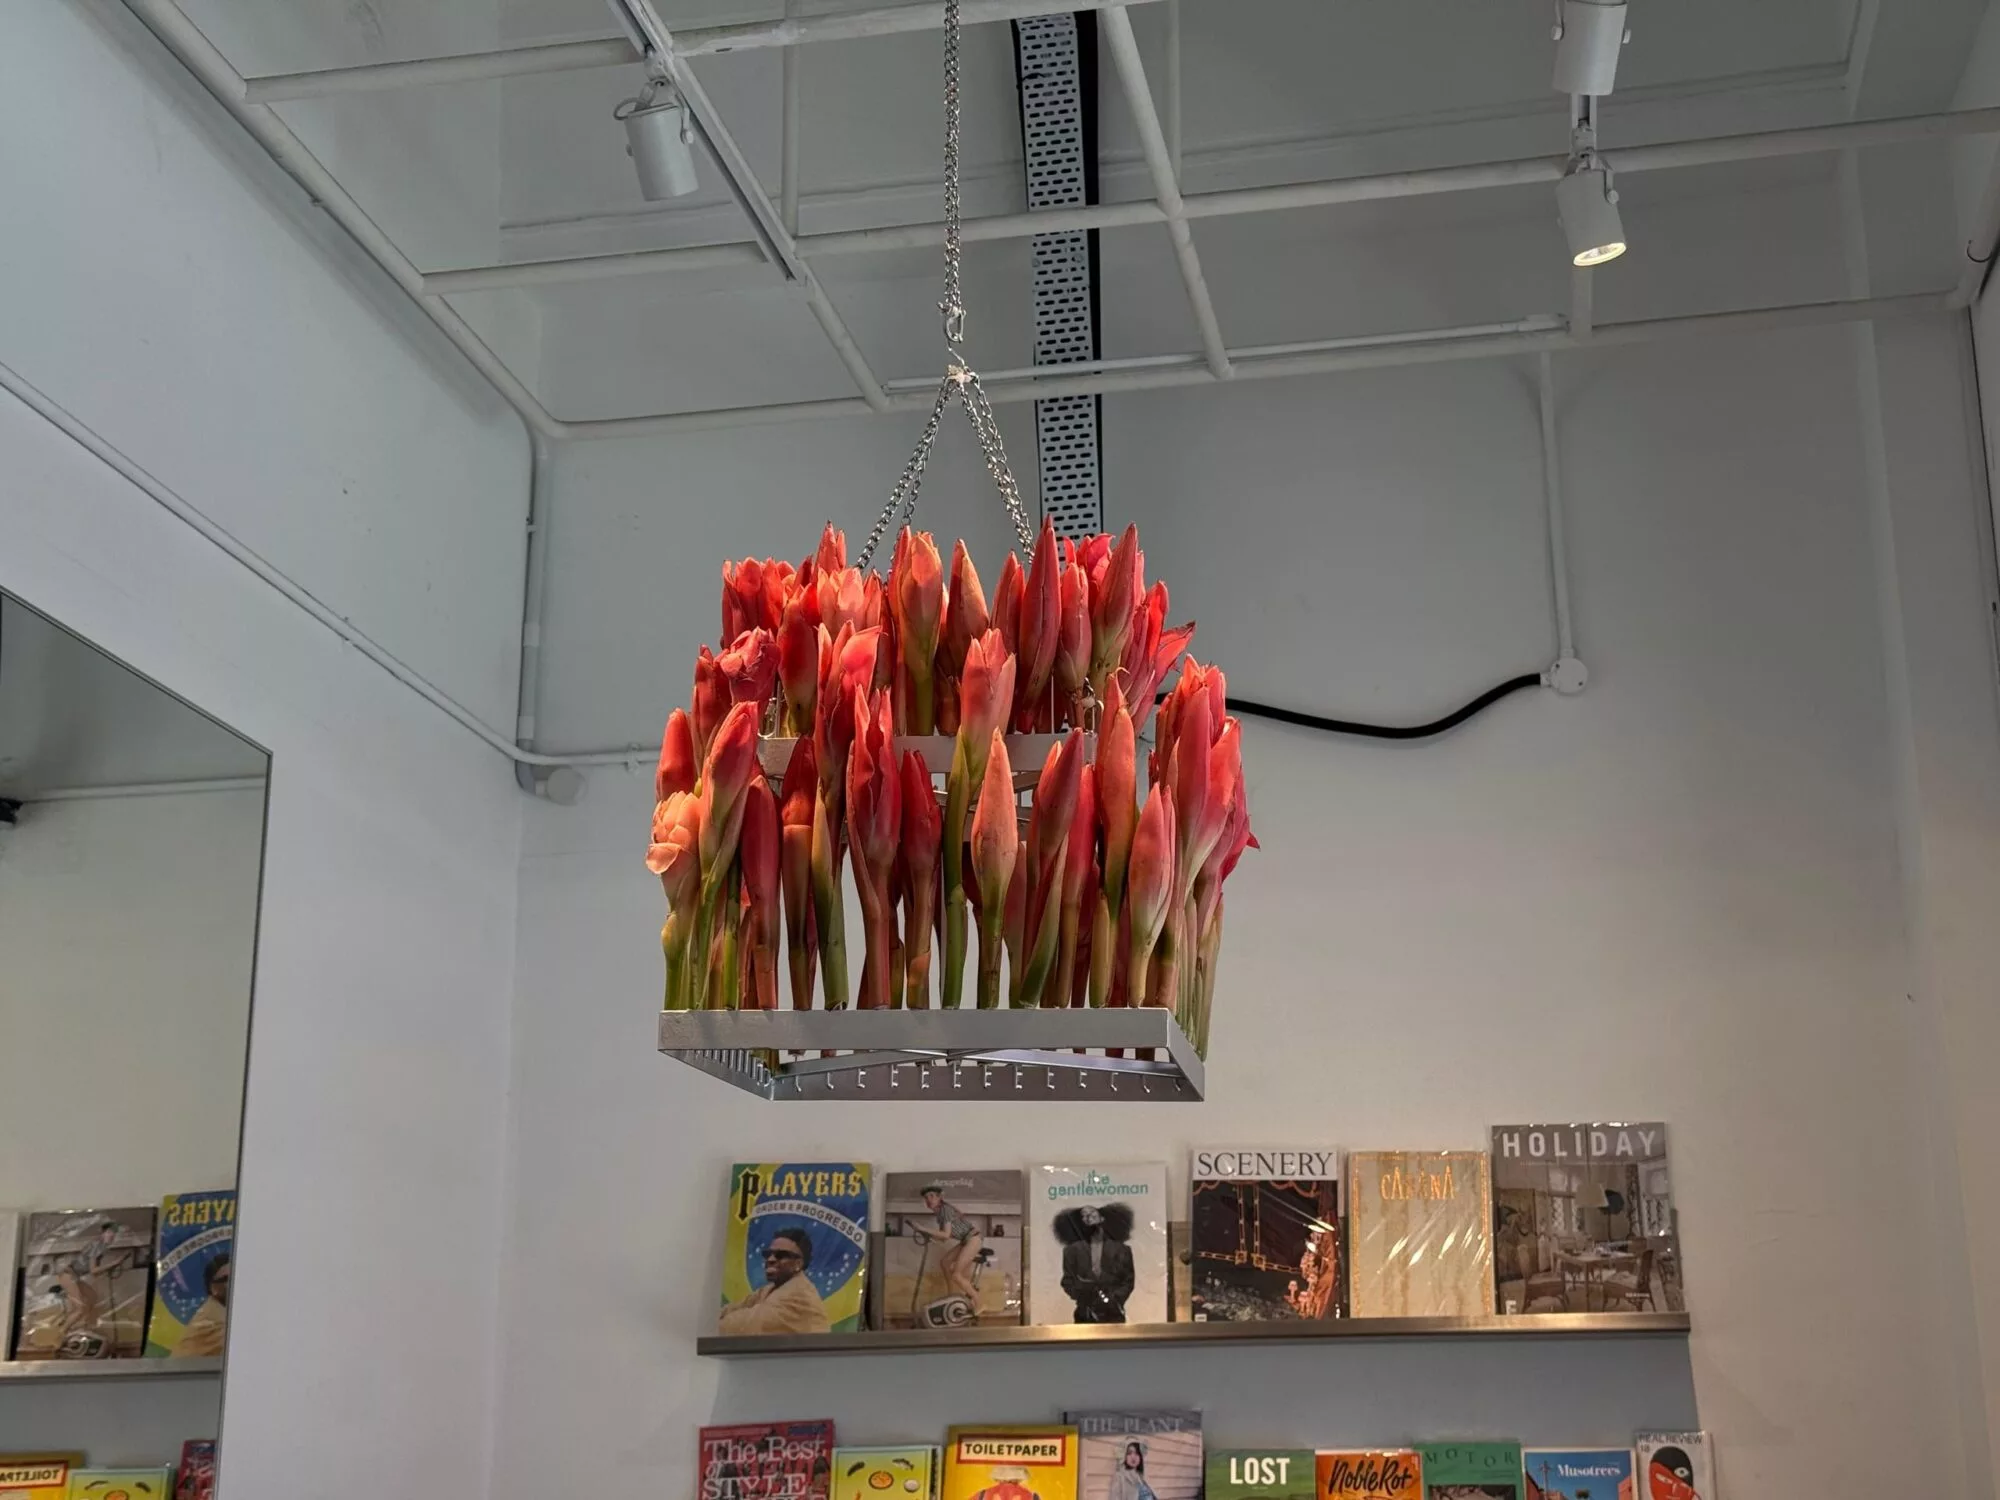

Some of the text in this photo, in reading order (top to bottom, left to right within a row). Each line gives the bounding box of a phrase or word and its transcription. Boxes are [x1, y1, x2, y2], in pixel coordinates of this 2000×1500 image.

[1502, 1130, 1657, 1158] HOLIDAY
[1087, 1169, 1110, 1185] the
[1198, 1152, 1333, 1177] SCENERY
[736, 1168, 862, 1224] PLAYERS
[1047, 1180, 1149, 1201] gentlewoman
[796, 1203, 863, 1242] PROGRESSO
[1080, 1418, 1185, 1433] THE PLANT
[703, 1434, 826, 1464] The Best
[965, 1443, 1058, 1457] TOILETPAPER
[1424, 1448, 1516, 1468] MOTOR
[1230, 1457, 1290, 1485] LOST
[1557, 1463, 1621, 1477] Musotrees
[702, 1474, 806, 1500] STYLE
